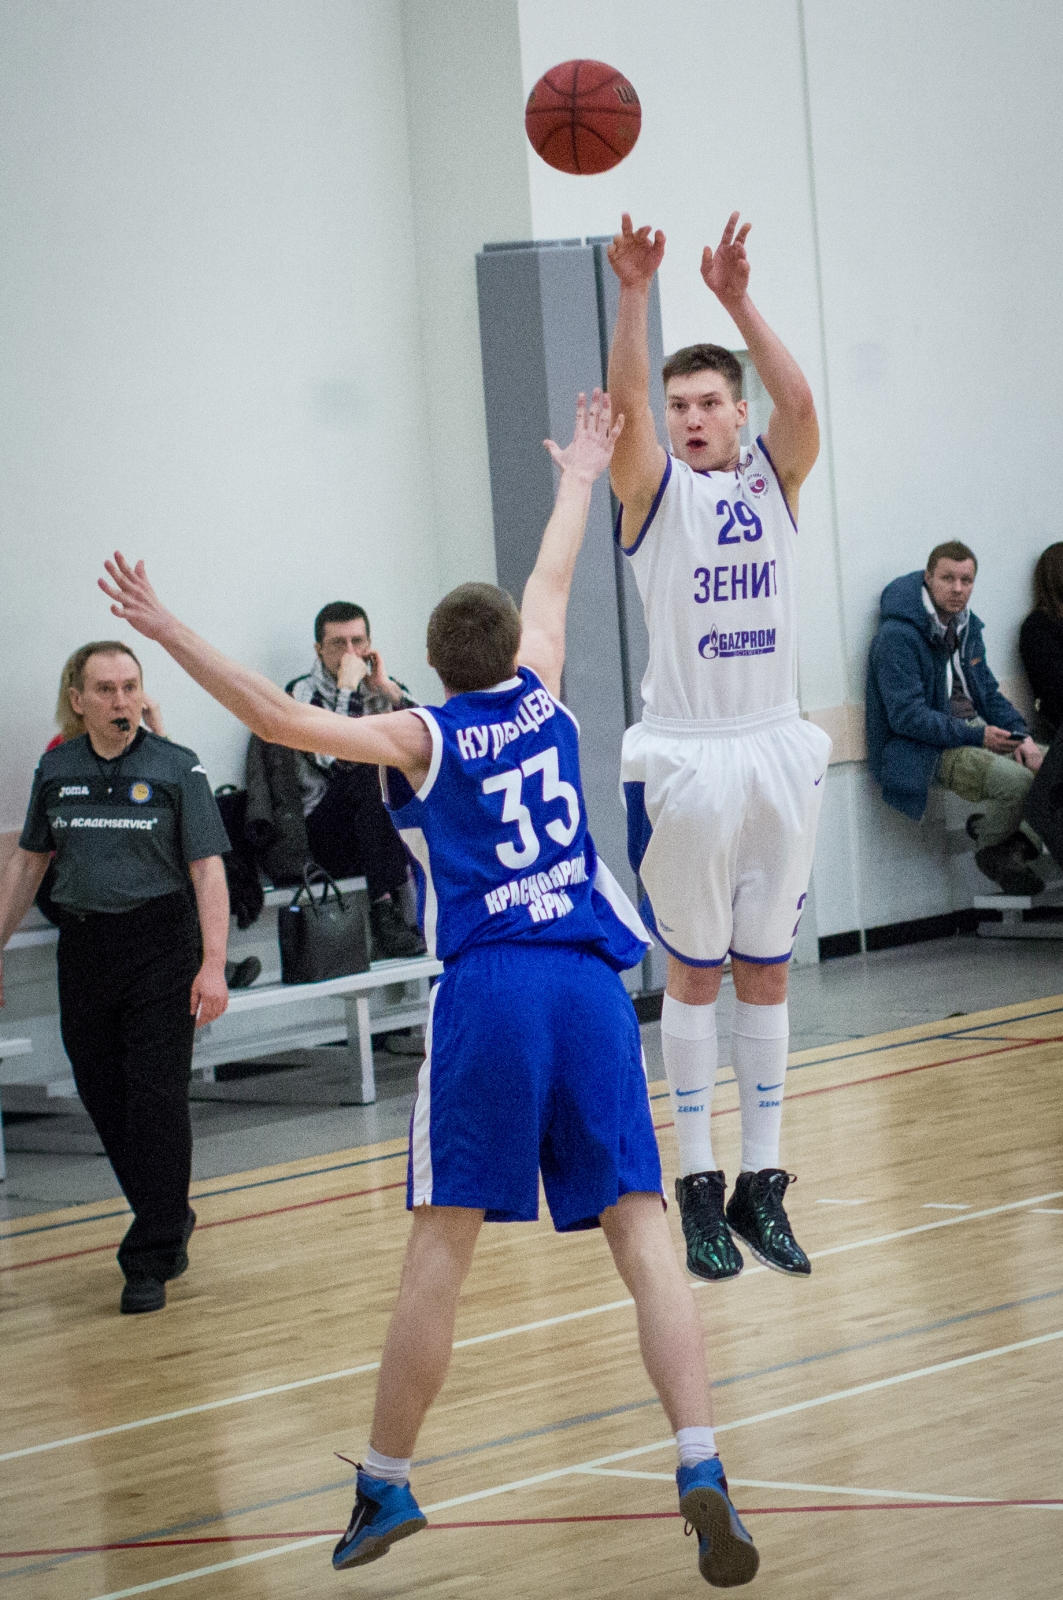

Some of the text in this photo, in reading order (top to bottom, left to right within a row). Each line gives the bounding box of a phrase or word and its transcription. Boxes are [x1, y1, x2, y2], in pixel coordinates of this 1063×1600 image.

[716, 500, 763, 545] 29
[719, 628, 776, 651] GAZPROM
[482, 746, 580, 869] 33
[677, 1104, 705, 1113] ZENIT
[758, 1100, 782, 1108] ZENI
